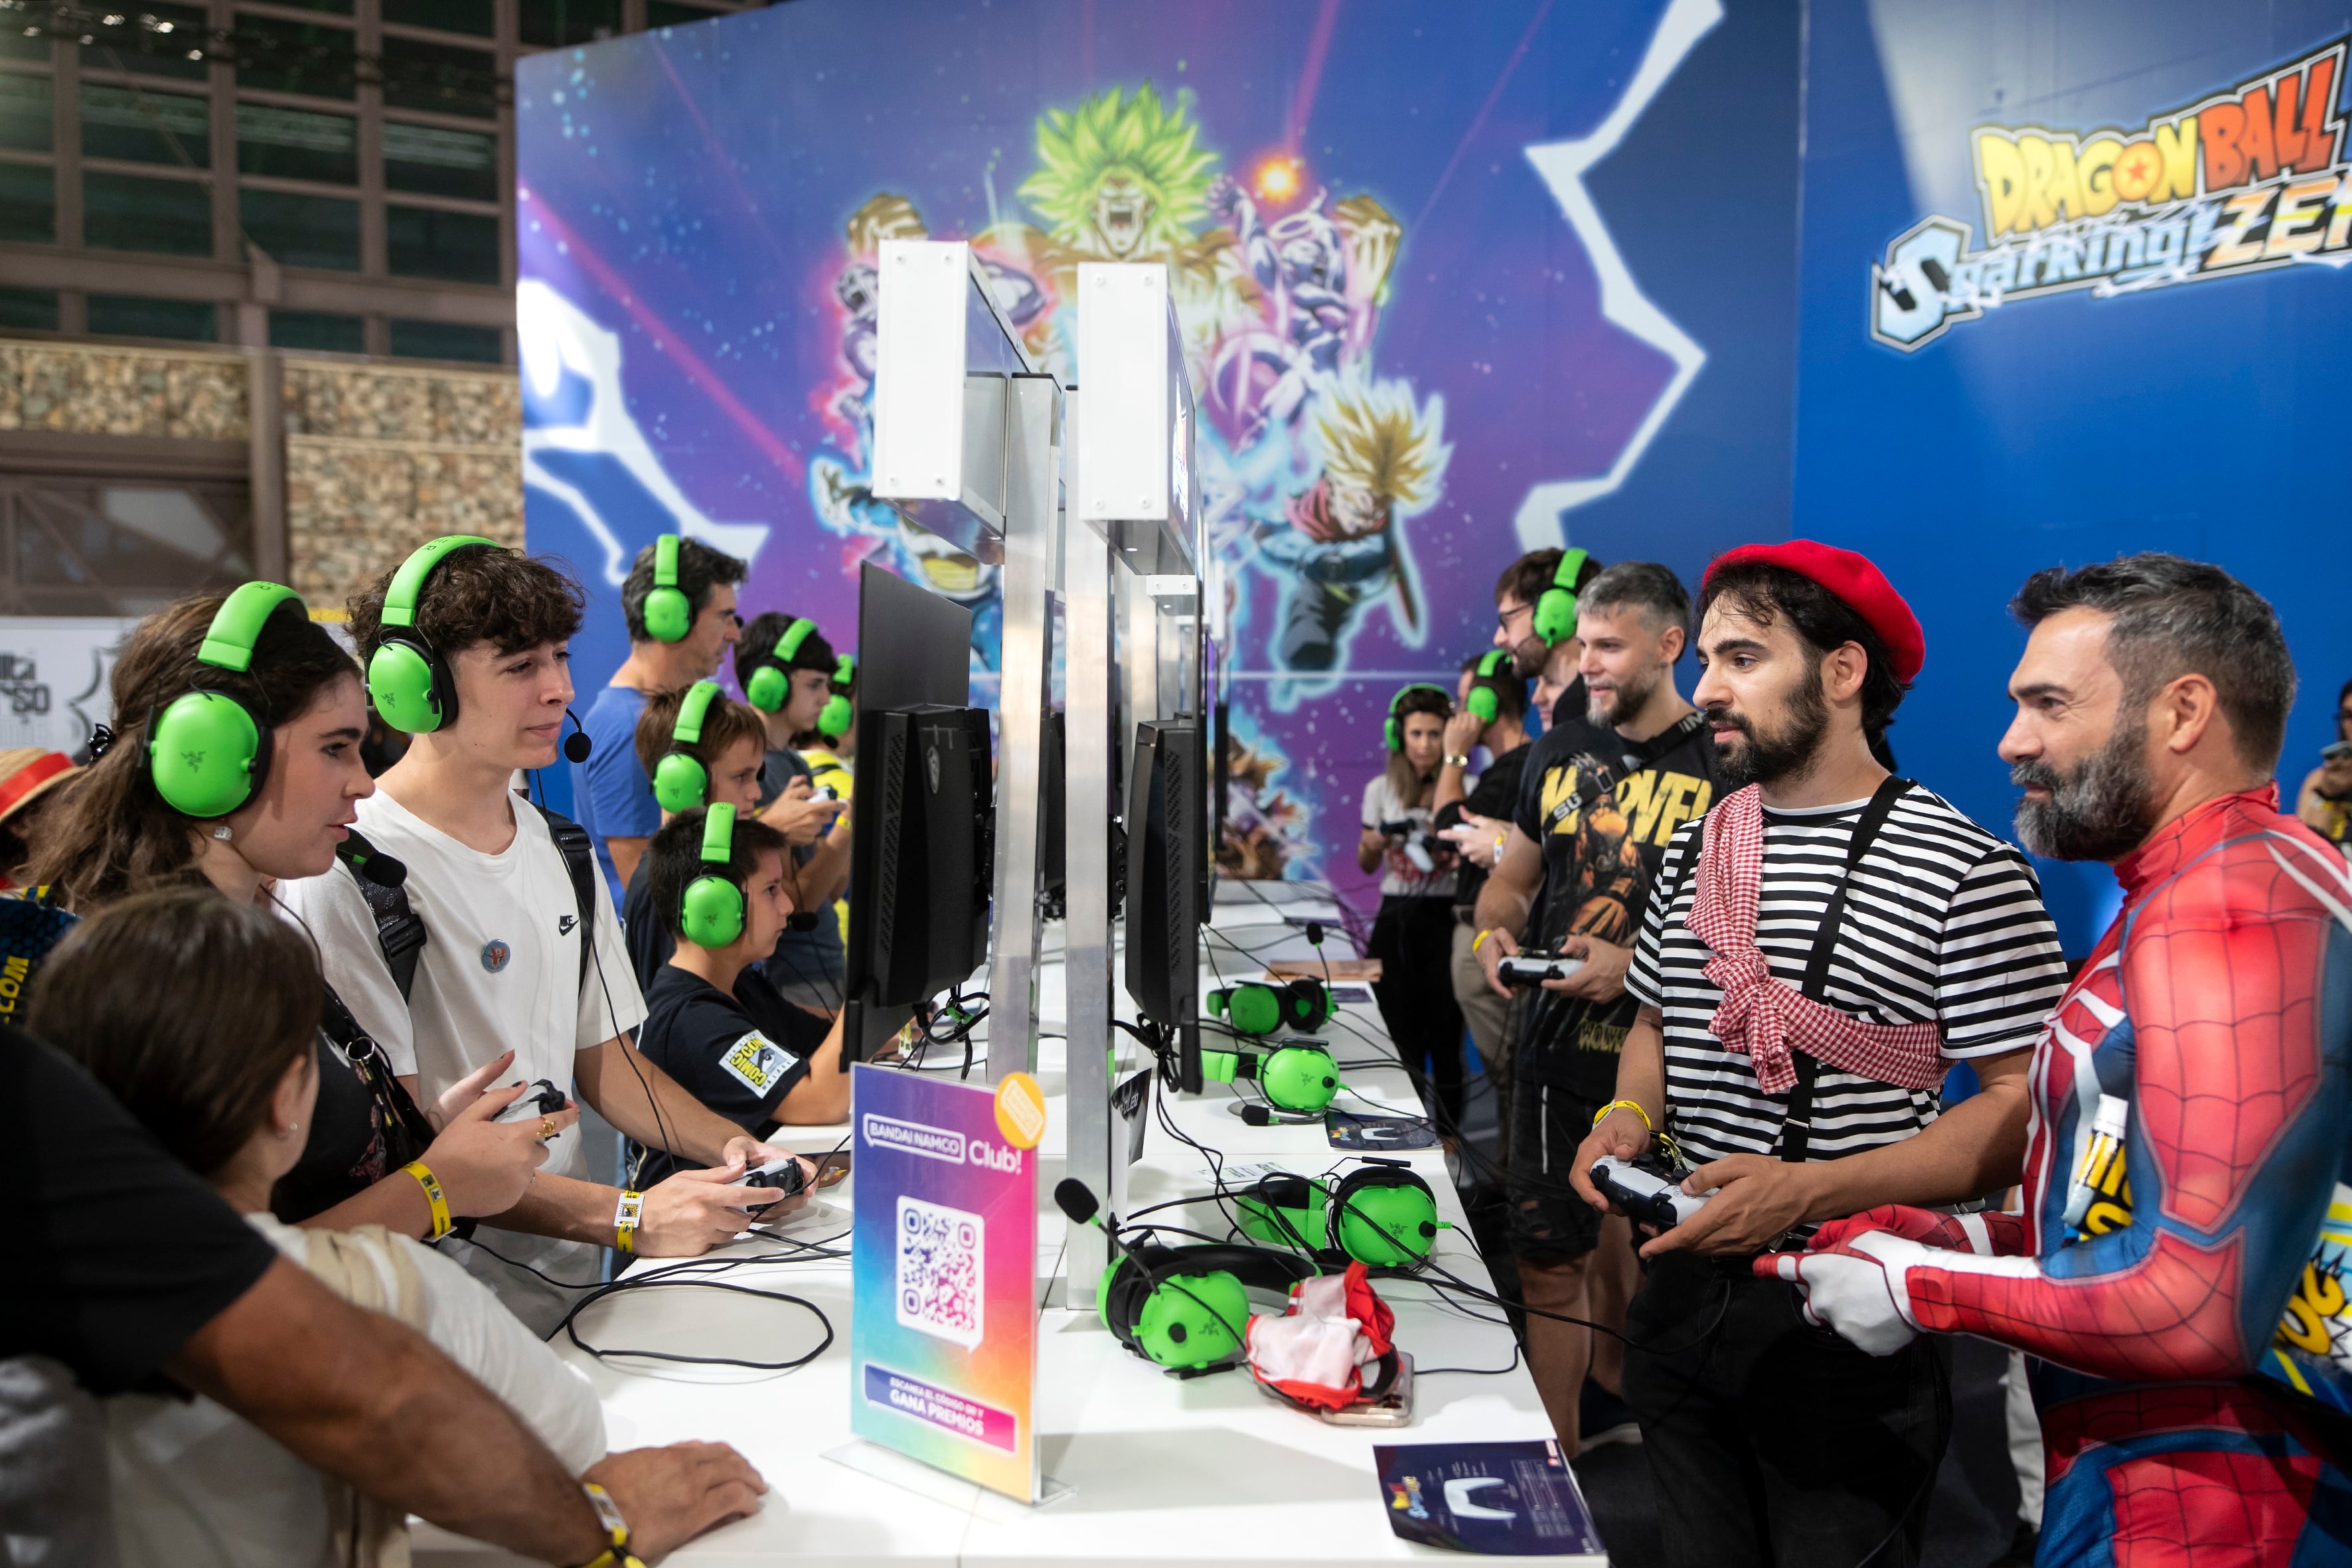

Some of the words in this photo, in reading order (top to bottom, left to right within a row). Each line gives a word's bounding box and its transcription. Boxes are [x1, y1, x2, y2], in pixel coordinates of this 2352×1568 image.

[1980, 118, 2198, 235] DRAGON
[2199, 56, 2336, 192] BALL
[560, 915, 573, 927] NIKE
[741, 1038, 765, 1058] CON
[730, 1052, 767, 1086] COMIC
[868, 1122, 913, 1143] BANDAI
[914, 1133, 959, 1155] NAMCO
[969, 1140, 1022, 1175] Club!
[890, 1377, 925, 1395] ESCANEA
[925, 1389, 934, 1400] EL
[935, 1393, 964, 1409] CÓDIGO
[890, 1389, 927, 1415] GANA
[927, 1402, 984, 1437] PREMIOS
